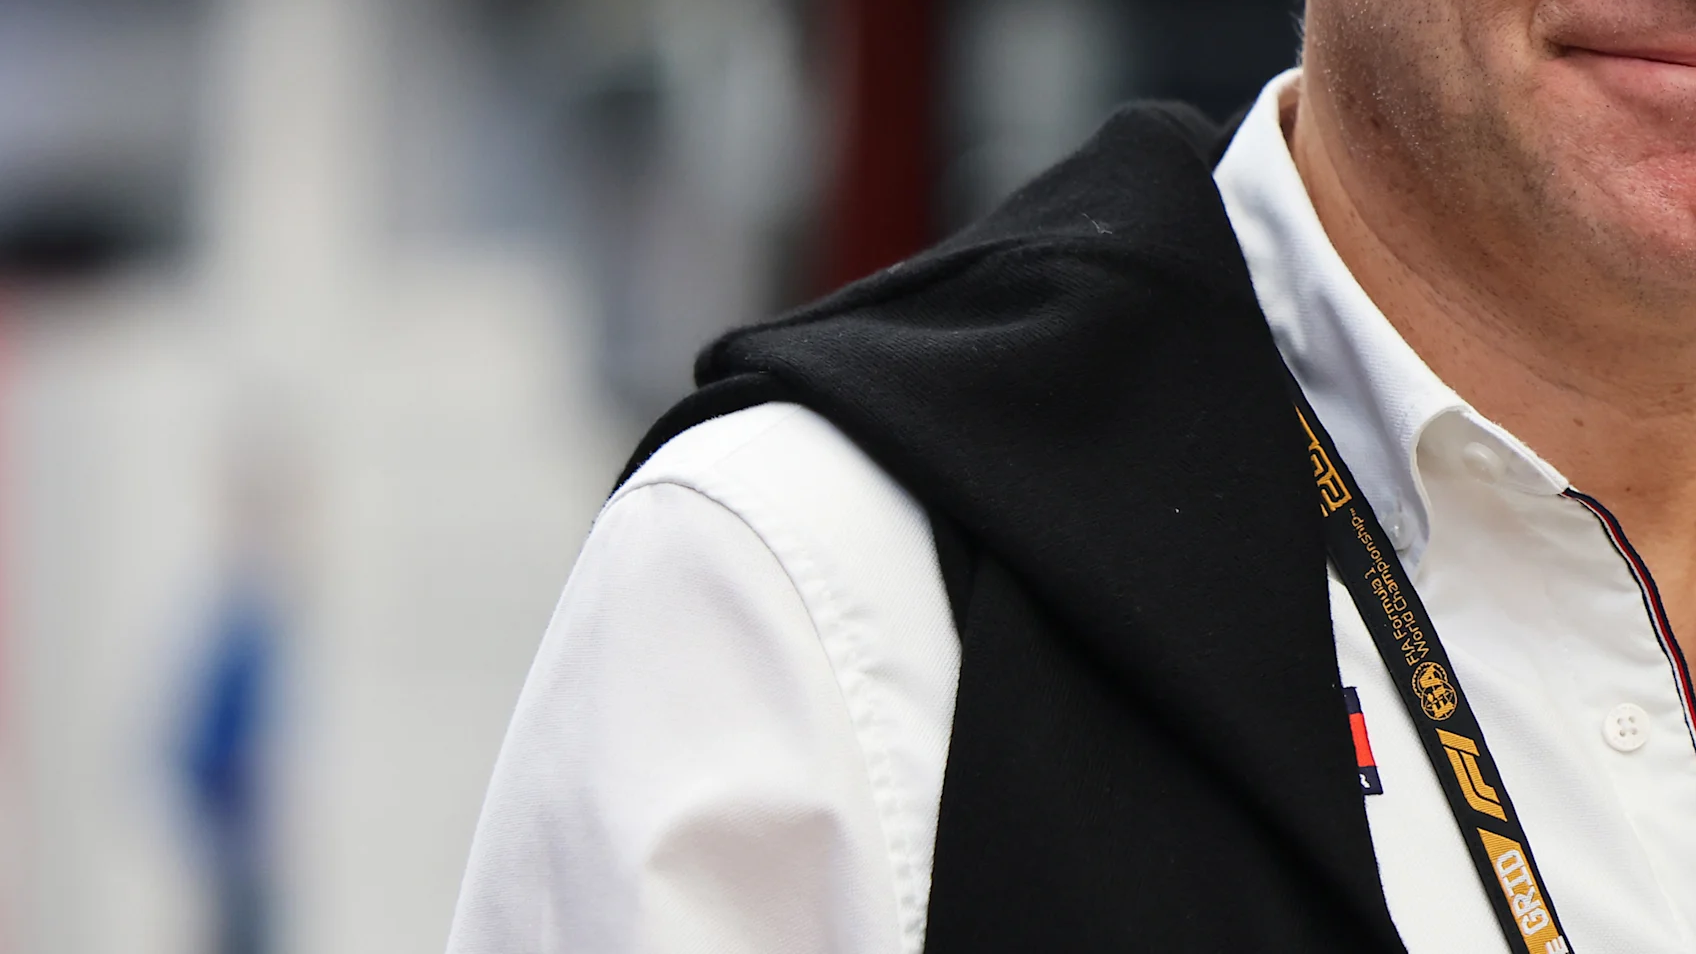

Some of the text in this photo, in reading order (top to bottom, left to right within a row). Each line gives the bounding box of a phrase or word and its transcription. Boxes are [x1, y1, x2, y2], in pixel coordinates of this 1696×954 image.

[1364, 566, 1420, 666] FIA Formula 1
[1401, 610, 1430, 659] World
[1435, 728, 1508, 822] F1
[1496, 849, 1550, 936] GRID
